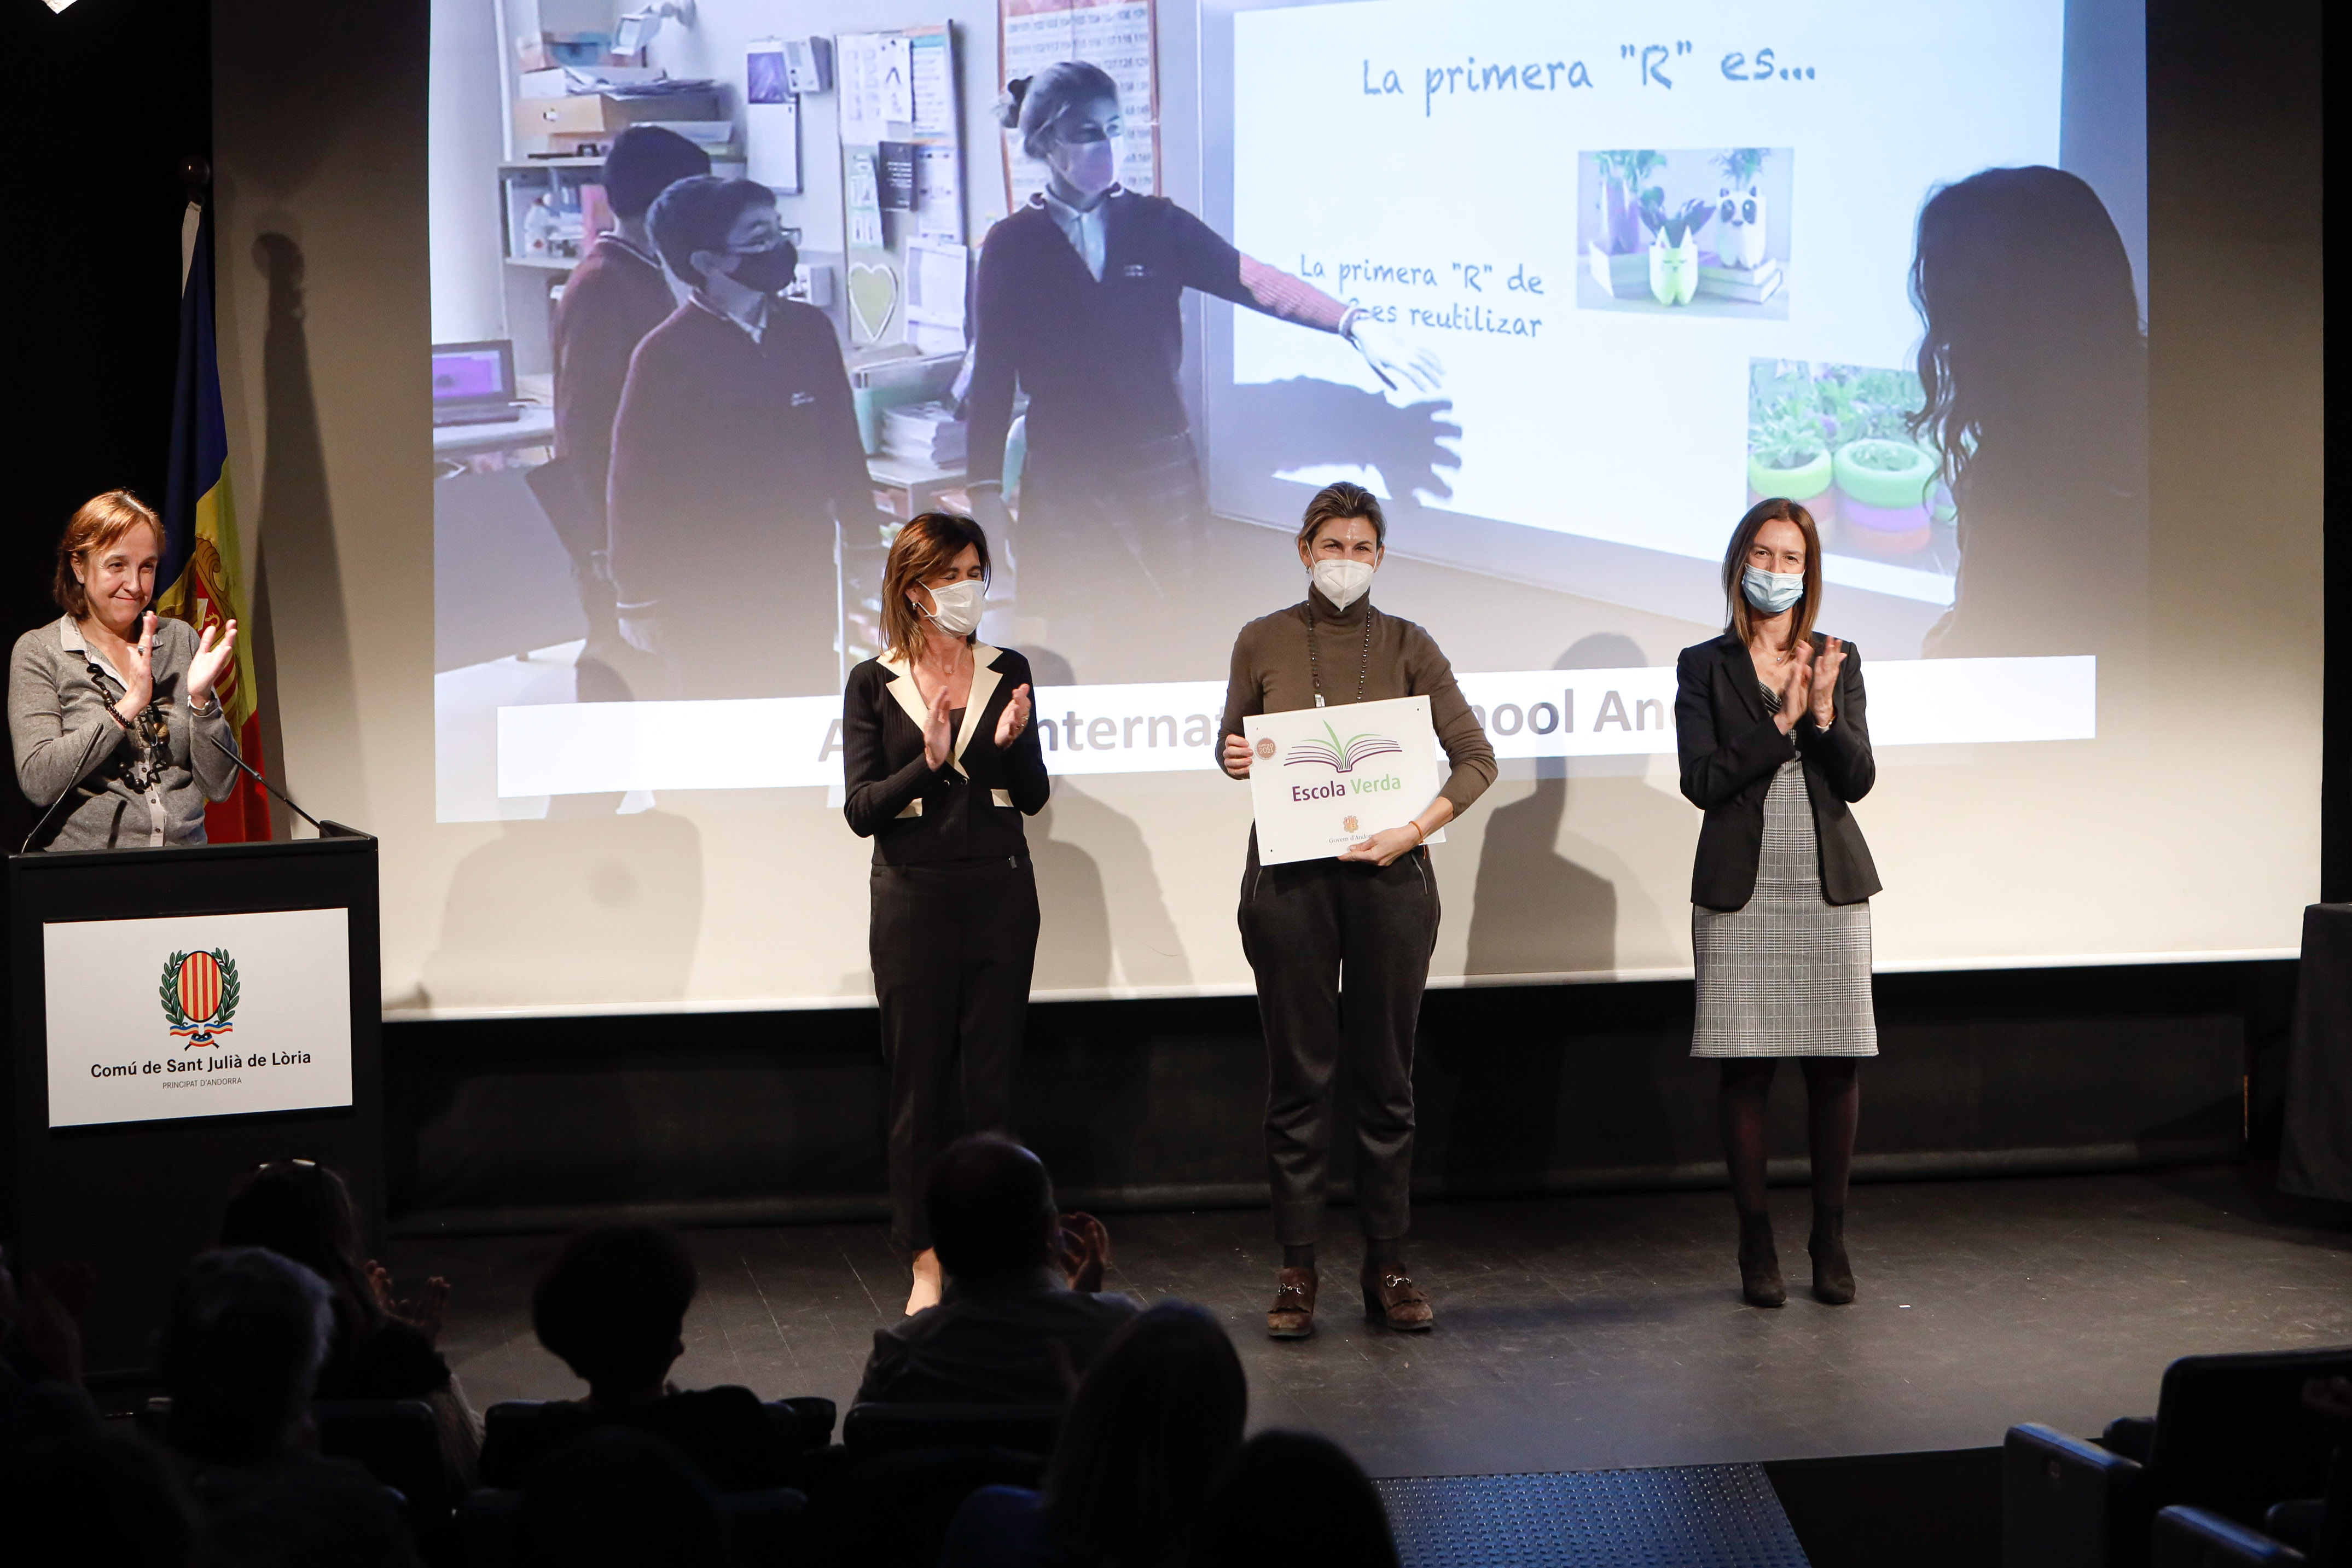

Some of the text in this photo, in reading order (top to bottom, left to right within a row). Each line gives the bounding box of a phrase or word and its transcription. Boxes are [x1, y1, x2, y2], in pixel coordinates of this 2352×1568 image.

[1363, 40, 1815, 117] La primera "R" es...
[1300, 254, 1544, 294] La primera "R" de
[1409, 303, 1542, 338] reutilizar
[1037, 706, 1224, 751] nterna
[1593, 690, 1676, 732] An
[1292, 774, 1401, 802] Escola Verda
[91, 1050, 311, 1078] Comú de Sant Julià de Lòria
[162, 1077, 242, 1089] PRINCIPAT D'ANDORRA
